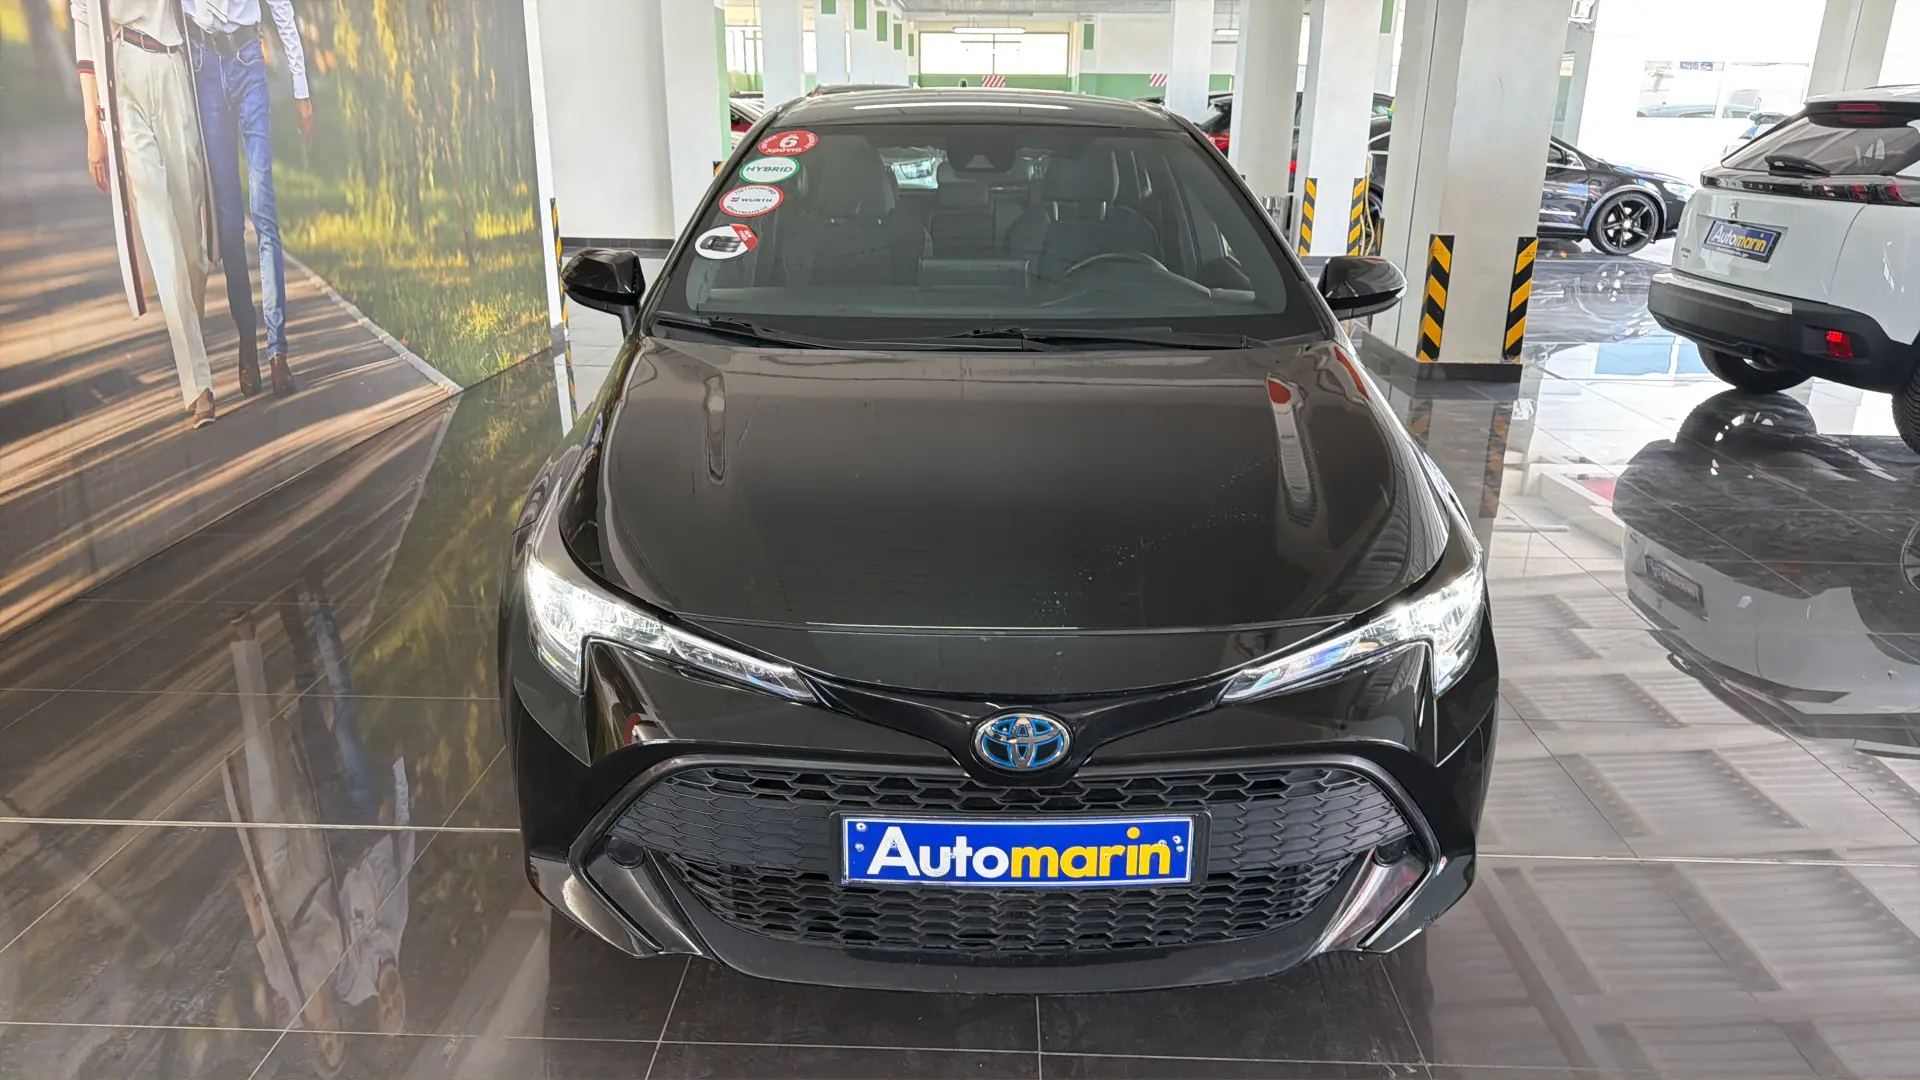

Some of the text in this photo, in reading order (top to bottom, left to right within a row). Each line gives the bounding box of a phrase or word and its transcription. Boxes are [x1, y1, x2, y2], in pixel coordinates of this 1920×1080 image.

[779, 135, 799, 148] 6
[1711, 224, 1768, 252] Automarin
[866, 826, 1170, 878] Automarin
